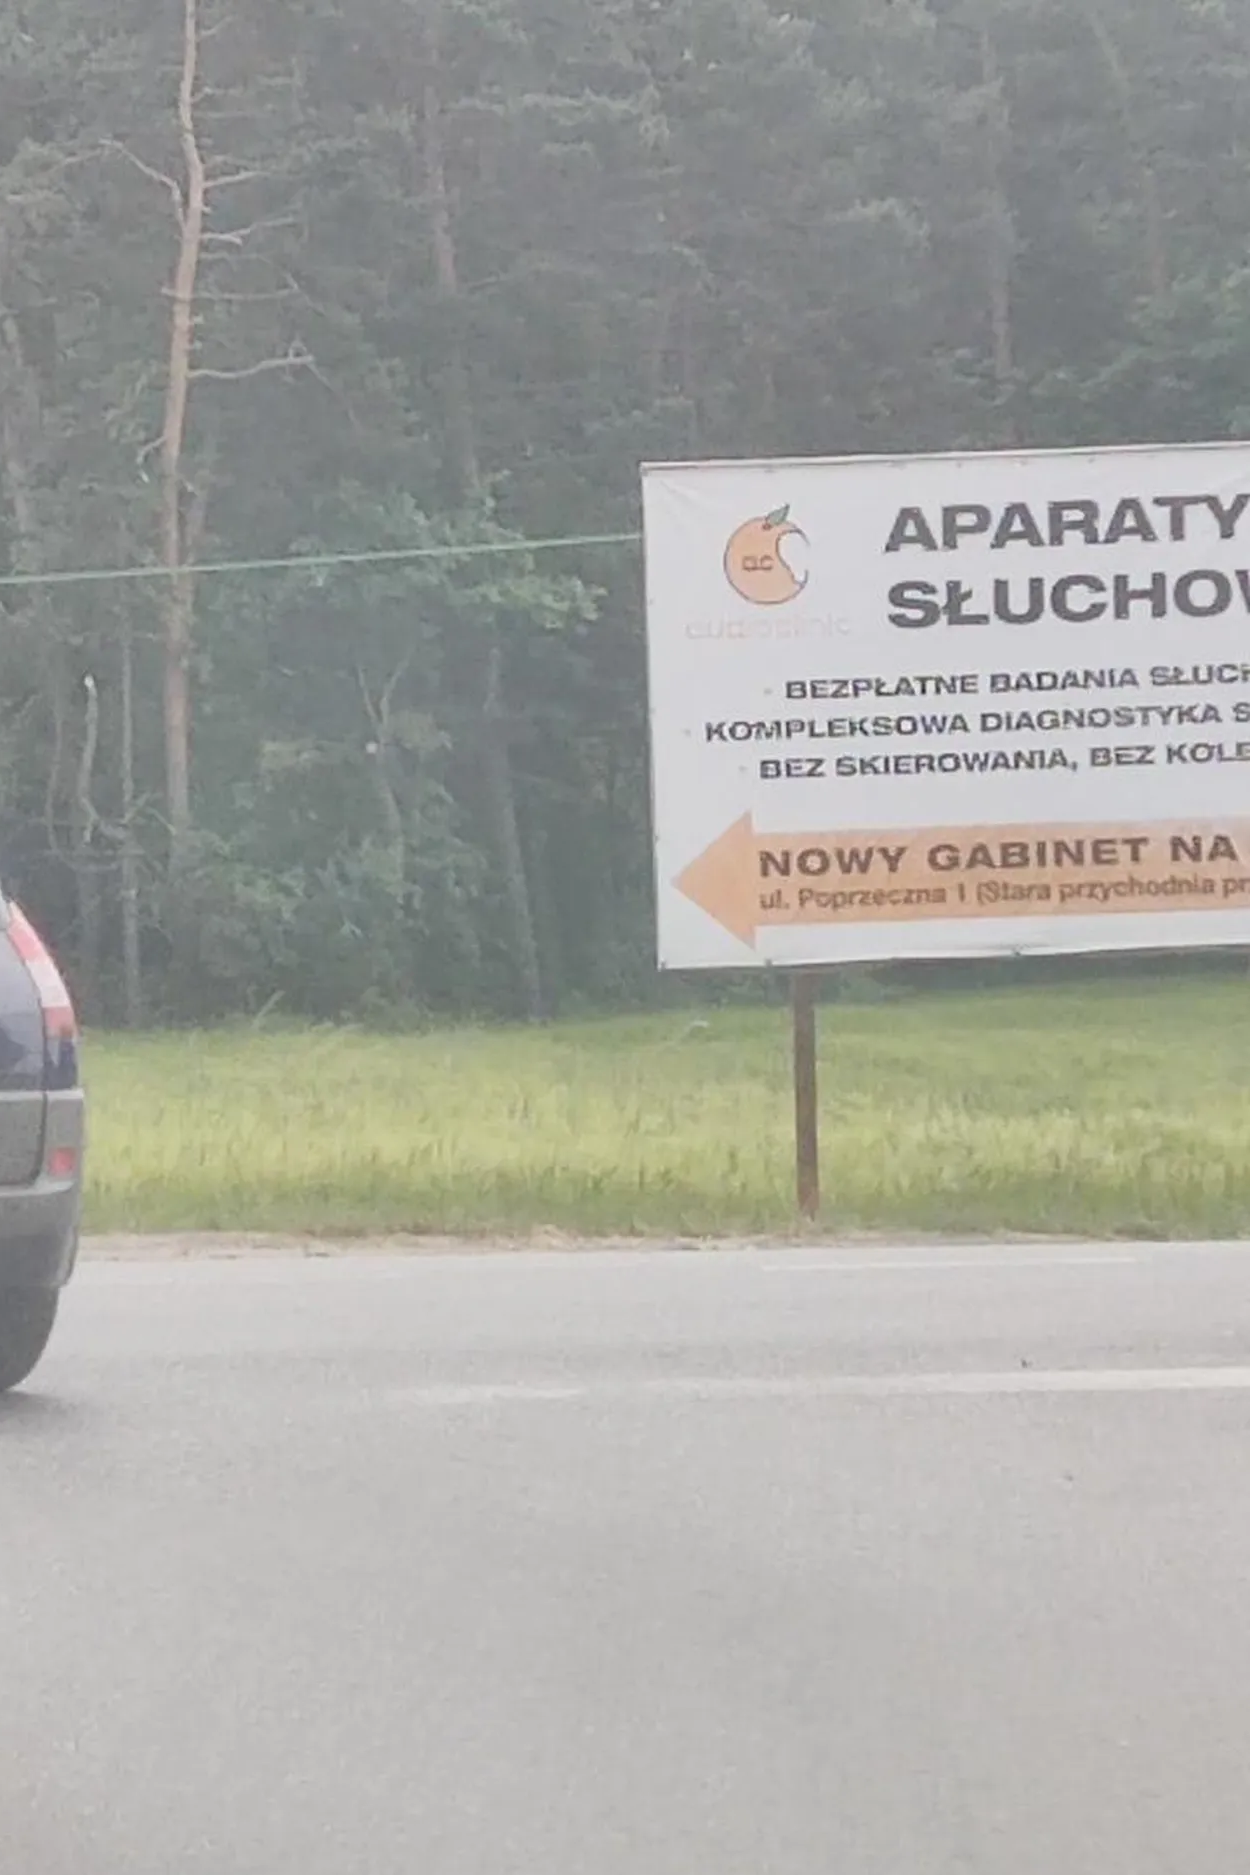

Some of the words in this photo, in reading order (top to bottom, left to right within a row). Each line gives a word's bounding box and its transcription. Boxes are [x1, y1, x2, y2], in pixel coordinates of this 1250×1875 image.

[883, 493, 1250, 552] APARATY
[887, 568, 1250, 629] SŁUCHO
[784, 673, 980, 699] BEZPŁATNE
[989, 667, 1140, 694] BADANIA
[705, 712, 971, 742] KOMPLEKSOWA
[980, 704, 1223, 733] DIAGNOSTYKA
[759, 758, 826, 779] BEZ
[835, 748, 1079, 777] SKIEROWANIA,
[1090, 745, 1156, 767] BEZ
[758, 846, 908, 878] NOWY
[927, 836, 1150, 871] GABINET
[1170, 833, 1239, 862] NA
[758, 888, 791, 910] ul.
[797, 885, 947, 912] Poprzeczna
[976, 879, 1052, 907] (Stara
[1058, 871, 1216, 903] przychodnia
